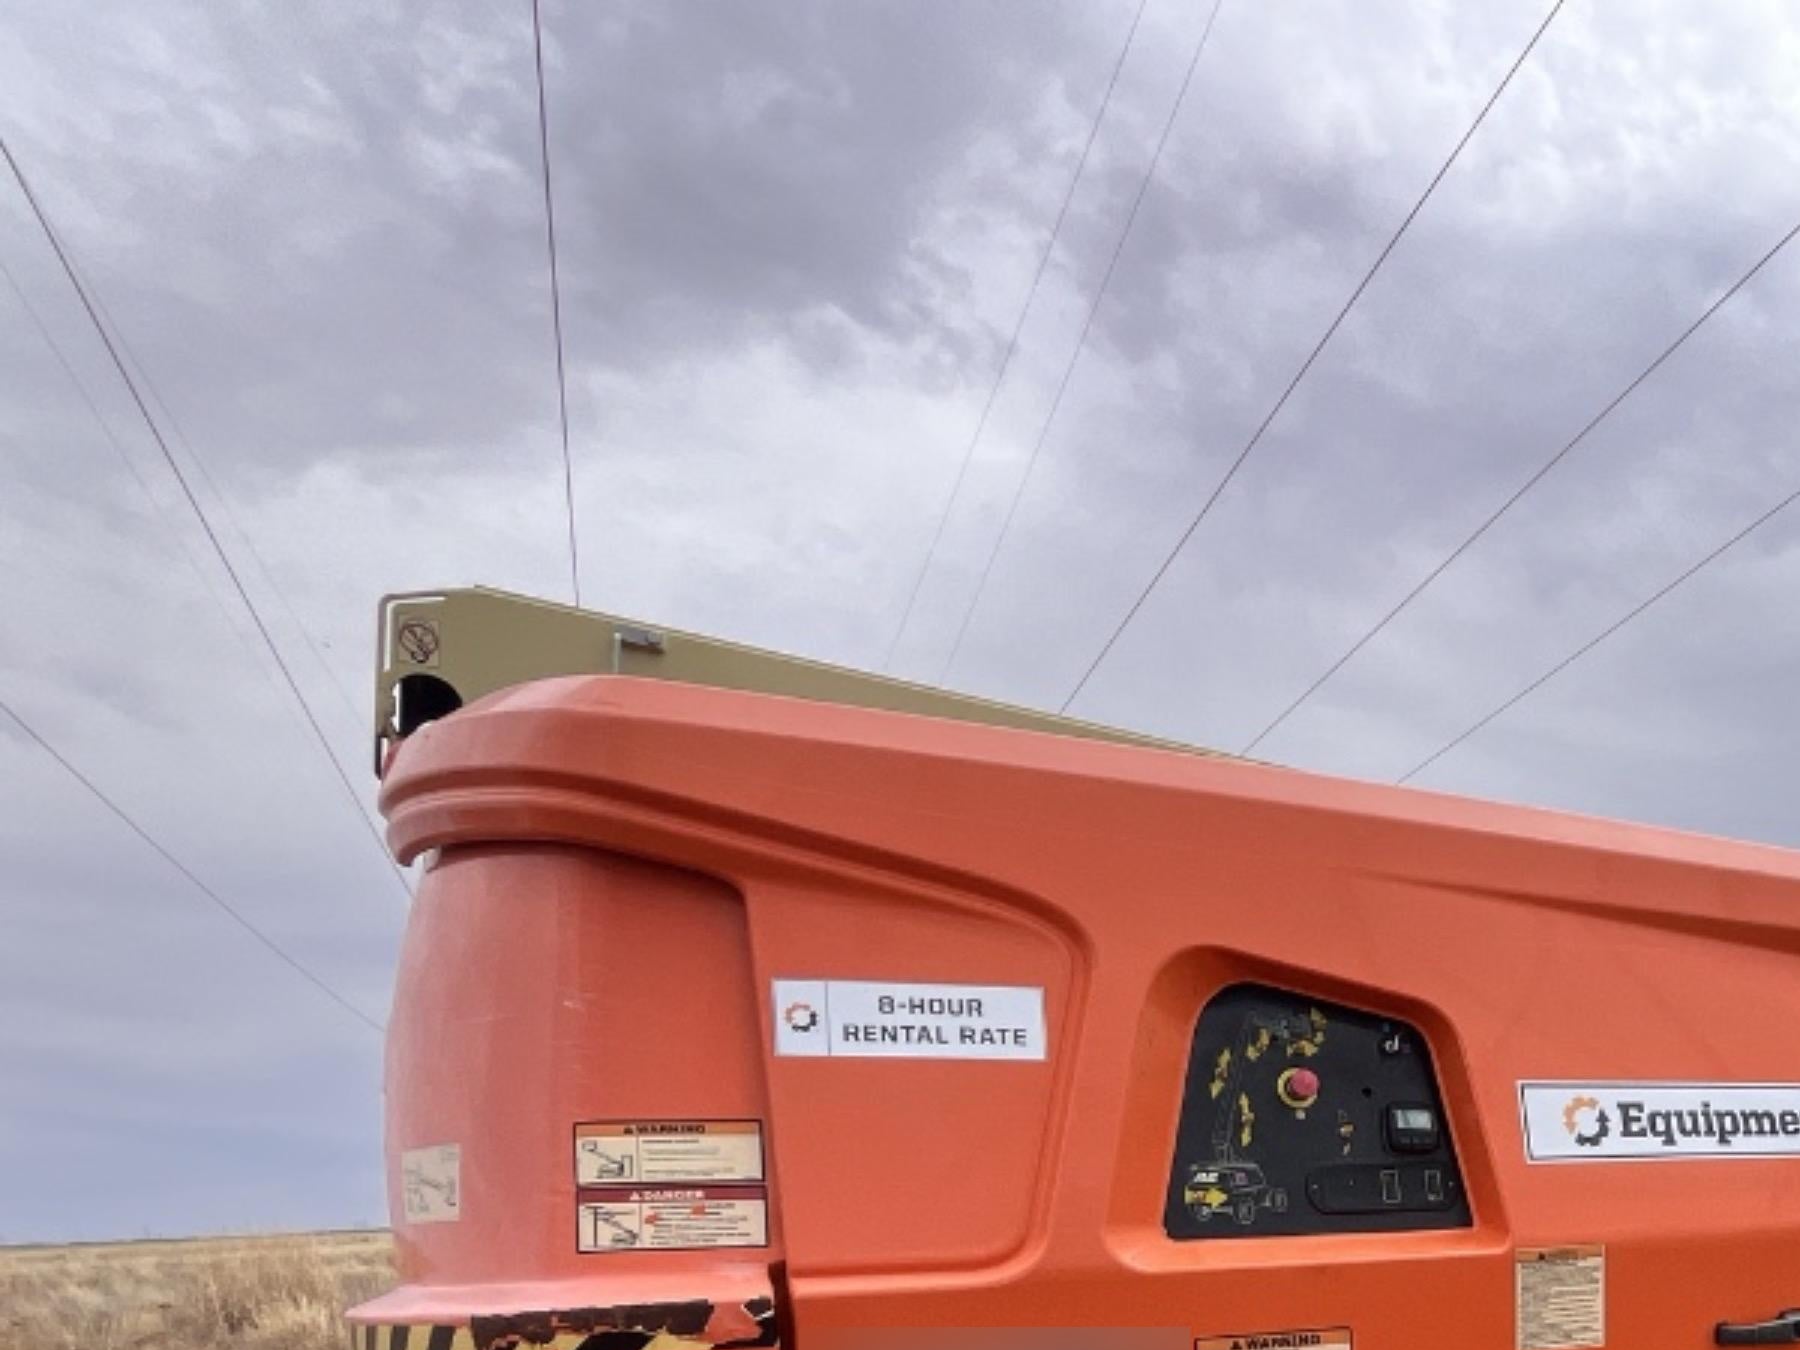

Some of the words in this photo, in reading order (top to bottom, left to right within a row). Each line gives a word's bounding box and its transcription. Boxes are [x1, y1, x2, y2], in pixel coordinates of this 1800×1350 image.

[878, 995, 983, 1018] 8-HOUR
[842, 1023, 949, 1045] RENTAL
[959, 1027, 1028, 1047] RATE
